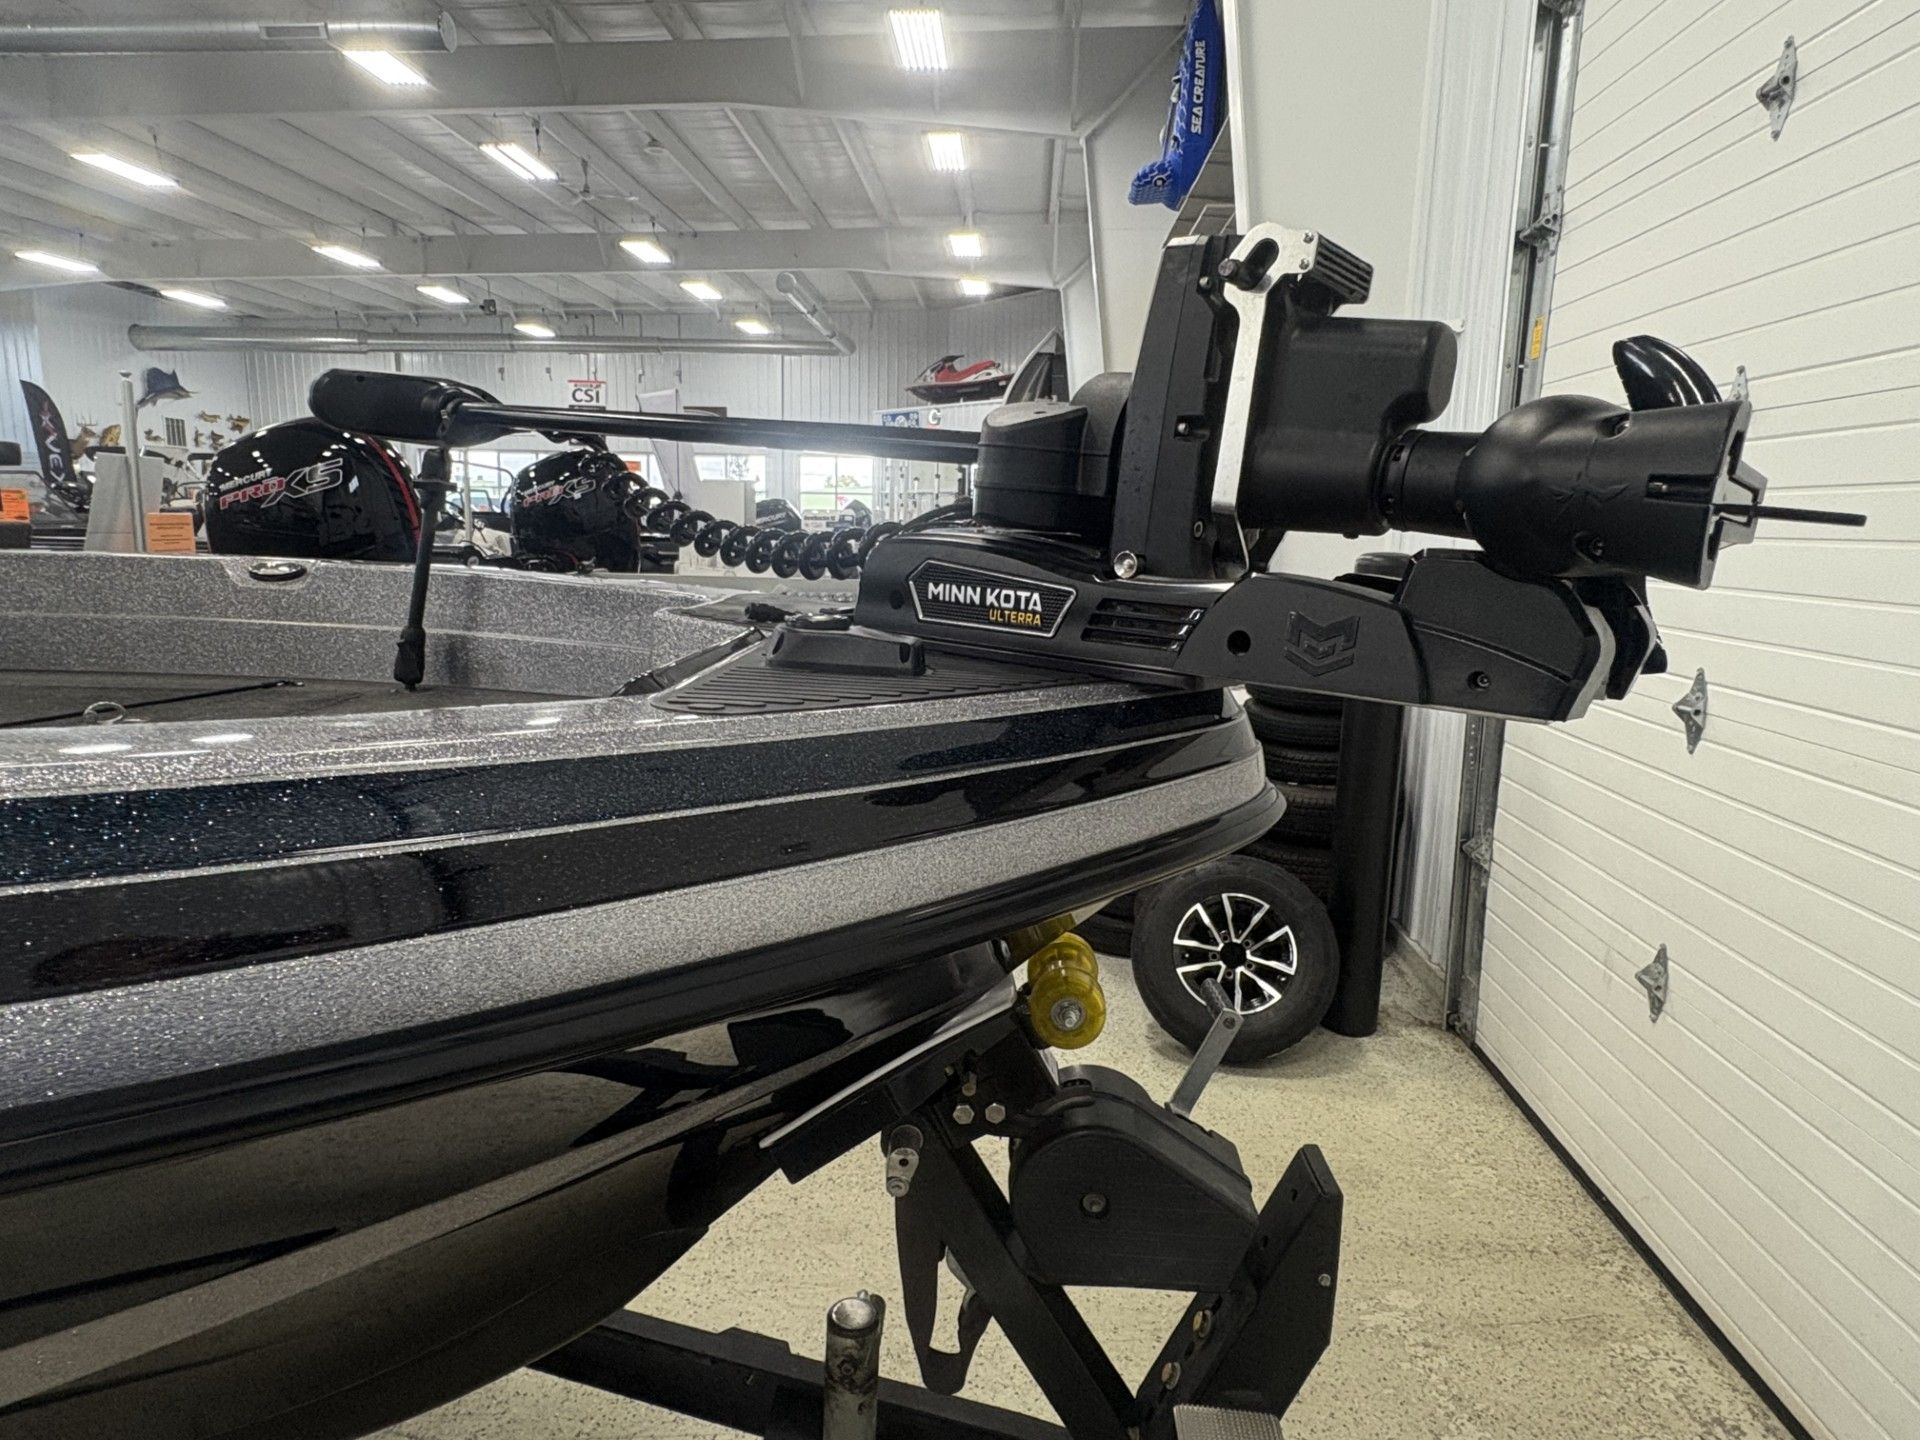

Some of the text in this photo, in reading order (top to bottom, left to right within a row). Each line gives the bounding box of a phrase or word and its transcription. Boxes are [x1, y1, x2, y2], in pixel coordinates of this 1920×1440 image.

[1191, 40, 1206, 134] SEA CREATURE
[571, 387, 600, 403] CSI
[927, 582, 1042, 612] MINN KOTA
[988, 608, 1041, 625] ULTERRA
